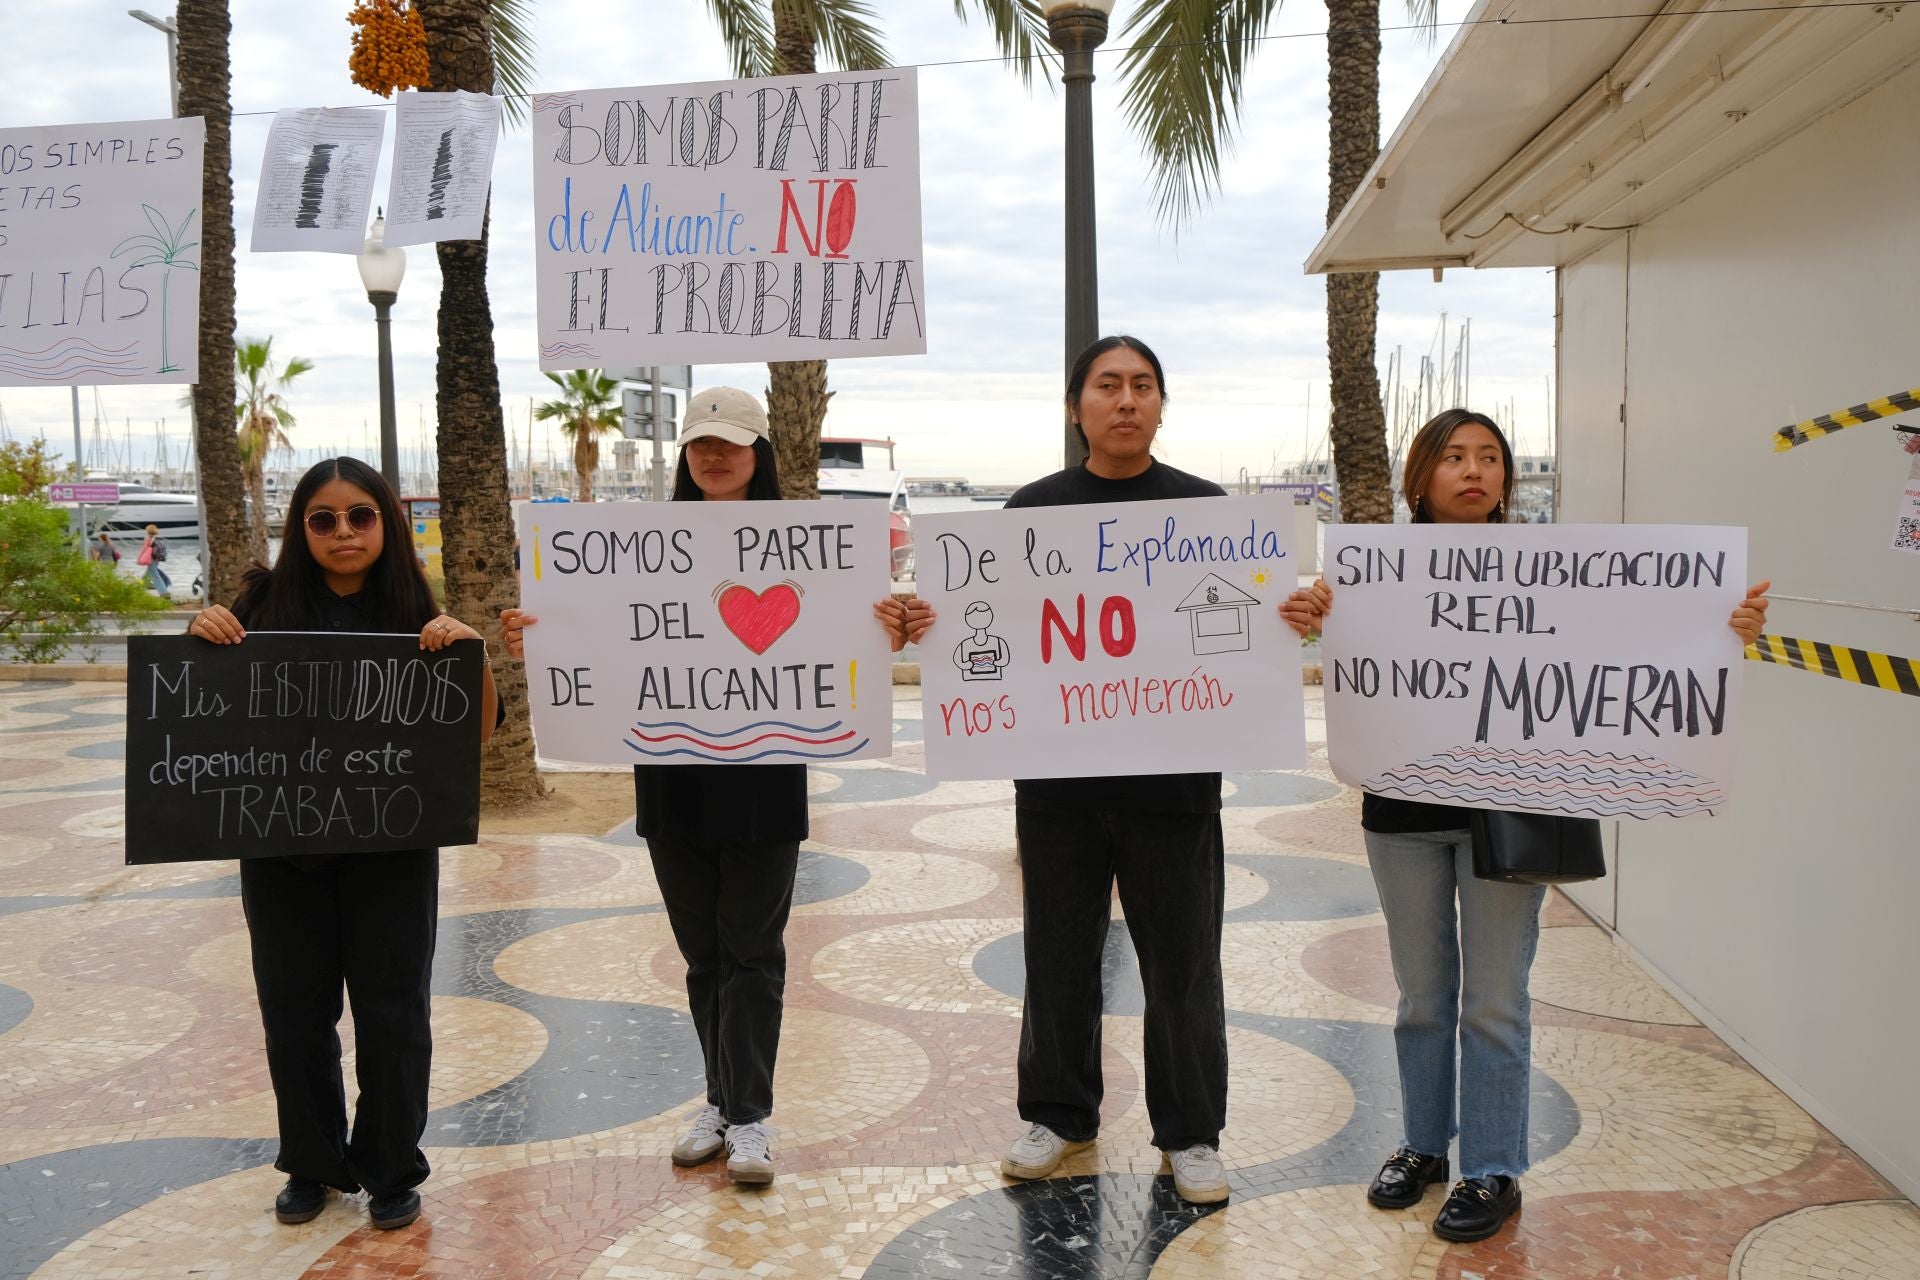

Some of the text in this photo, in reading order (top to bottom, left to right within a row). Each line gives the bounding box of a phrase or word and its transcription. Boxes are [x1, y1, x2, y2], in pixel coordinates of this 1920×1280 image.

[43, 136, 184, 168] SIMPLES
[553, 78, 900, 173] SOMOS PARTE
[548, 176, 598, 255] de
[602, 181, 757, 256] Alicante.
[771, 178, 858, 259] NO
[558, 257, 922, 341] EL PROBLEMA
[734, 523, 855, 573] PARTE
[936, 515, 1287, 592] De la Explanada
[1336, 545, 1726, 588] SIN UNA UBICACION
[629, 602, 705, 641] DEL
[1040, 593, 1137, 664] NO
[1425, 591, 1556, 635] REAL
[147, 657, 470, 726] Mis ESTUDIOS
[546, 659, 857, 711] DE ALICANTE!
[939, 665, 1234, 737] nos moverán
[1334, 656, 1729, 744] NO NOS MOVERAN
[149, 734, 415, 795] dependen de este
[201, 784, 423, 839] TRABAJO
